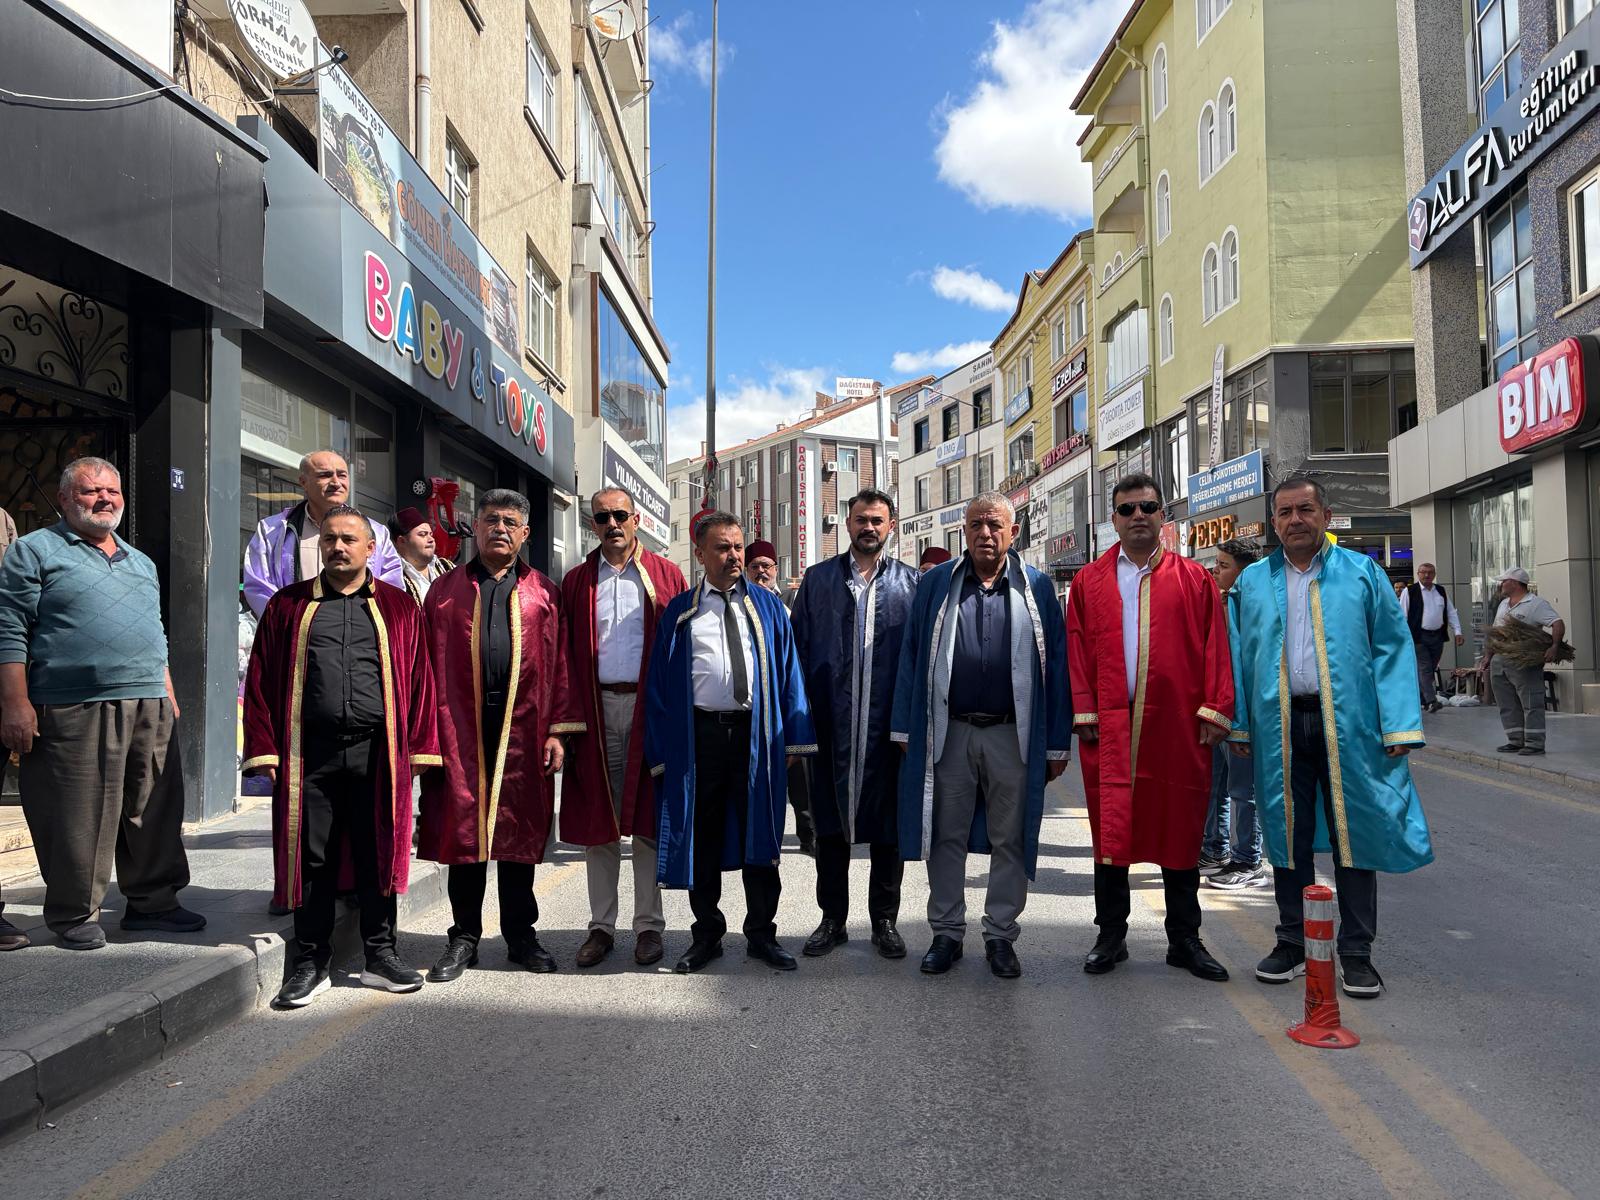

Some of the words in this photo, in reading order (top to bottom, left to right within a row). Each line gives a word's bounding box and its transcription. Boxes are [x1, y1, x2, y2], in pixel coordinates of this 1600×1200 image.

[238, 1, 307, 55] ORHAN
[1508, 65, 1596, 162] kurumları
[397, 179, 442, 257] GÖNEN
[1429, 127, 1506, 236] ALFA
[364, 250, 465, 391] BABY
[470, 347, 486, 404] &
[490, 361, 547, 456] TOYS
[1501, 355, 1573, 440] BİM
[614, 461, 642, 500] YILMAZ
[642, 488, 666, 520] TİCARET
[1233, 469, 1258, 490] MERKEZİ
